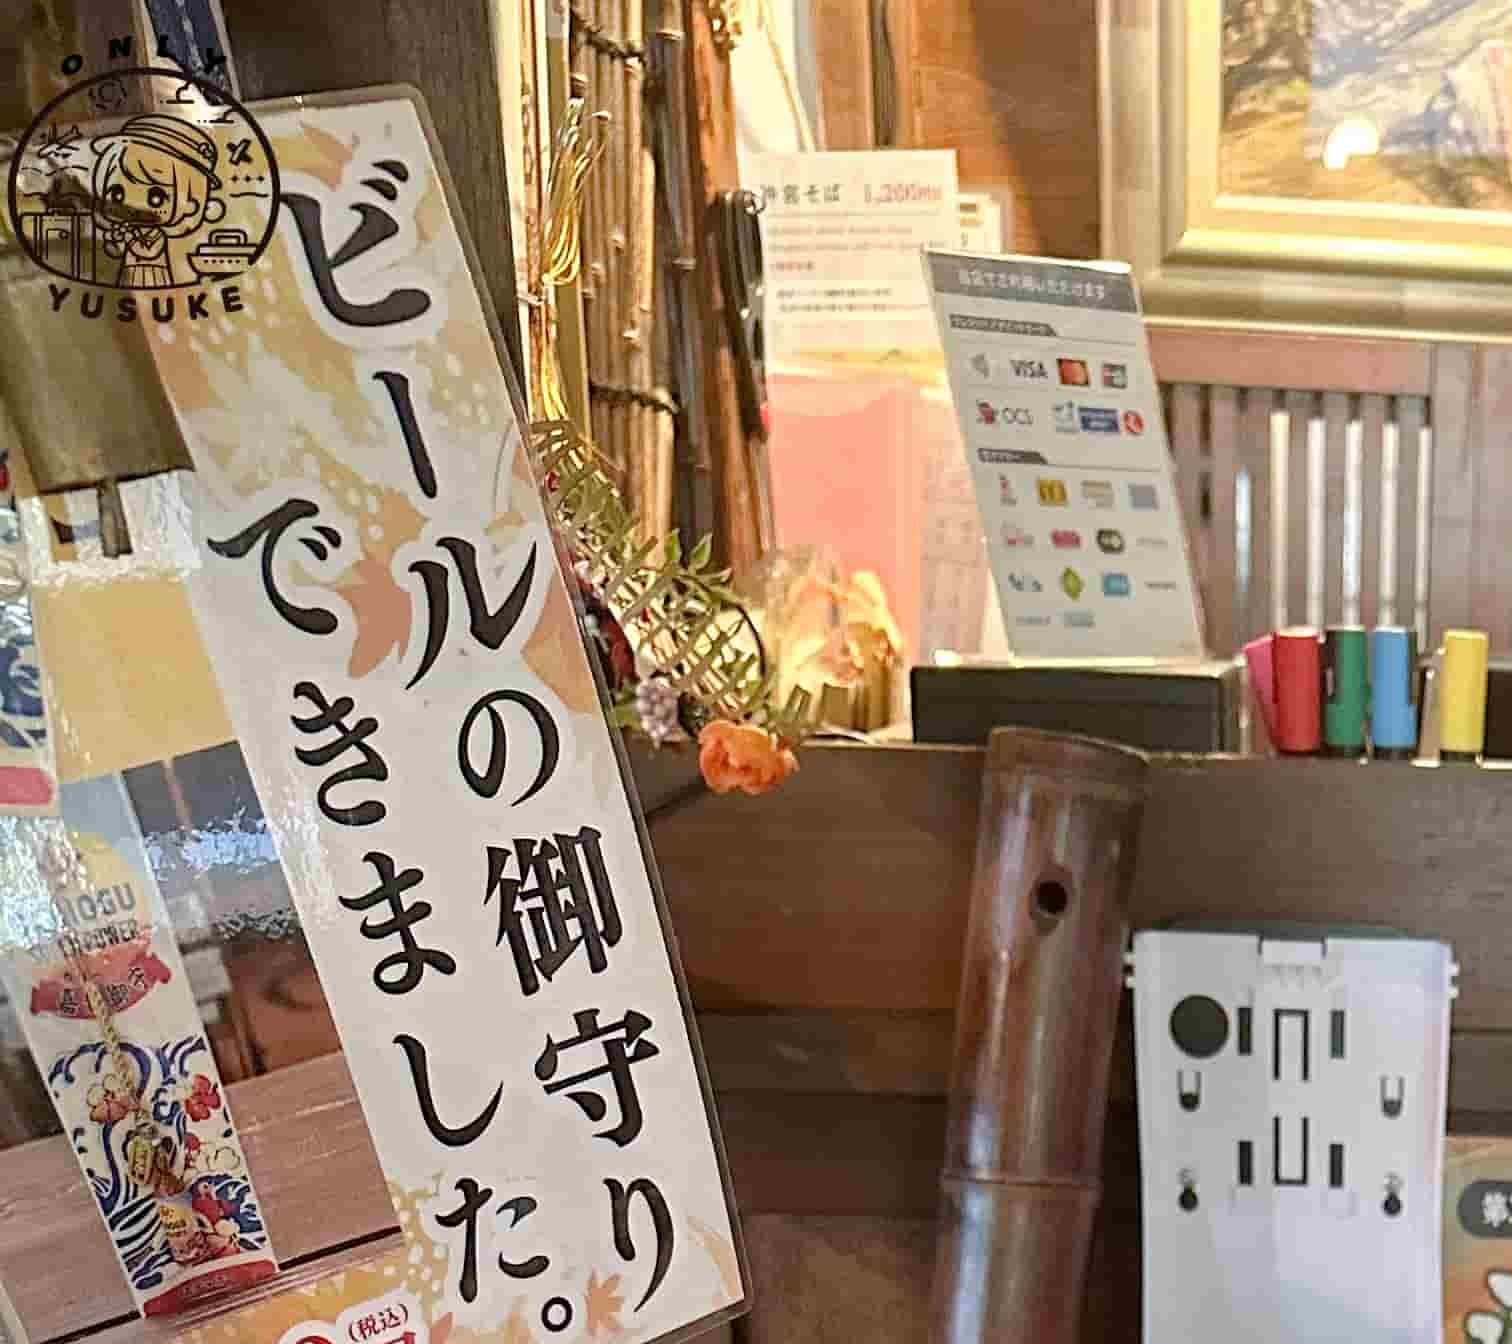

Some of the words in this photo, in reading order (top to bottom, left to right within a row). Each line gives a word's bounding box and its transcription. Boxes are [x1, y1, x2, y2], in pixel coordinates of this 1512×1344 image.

[1010, 359, 1048, 379] VISA
[208, 498, 571, 1336] できました。
[282, 160, 675, 1313] ビールの御守り
[347, 1303, 410, 1342] (税込)
